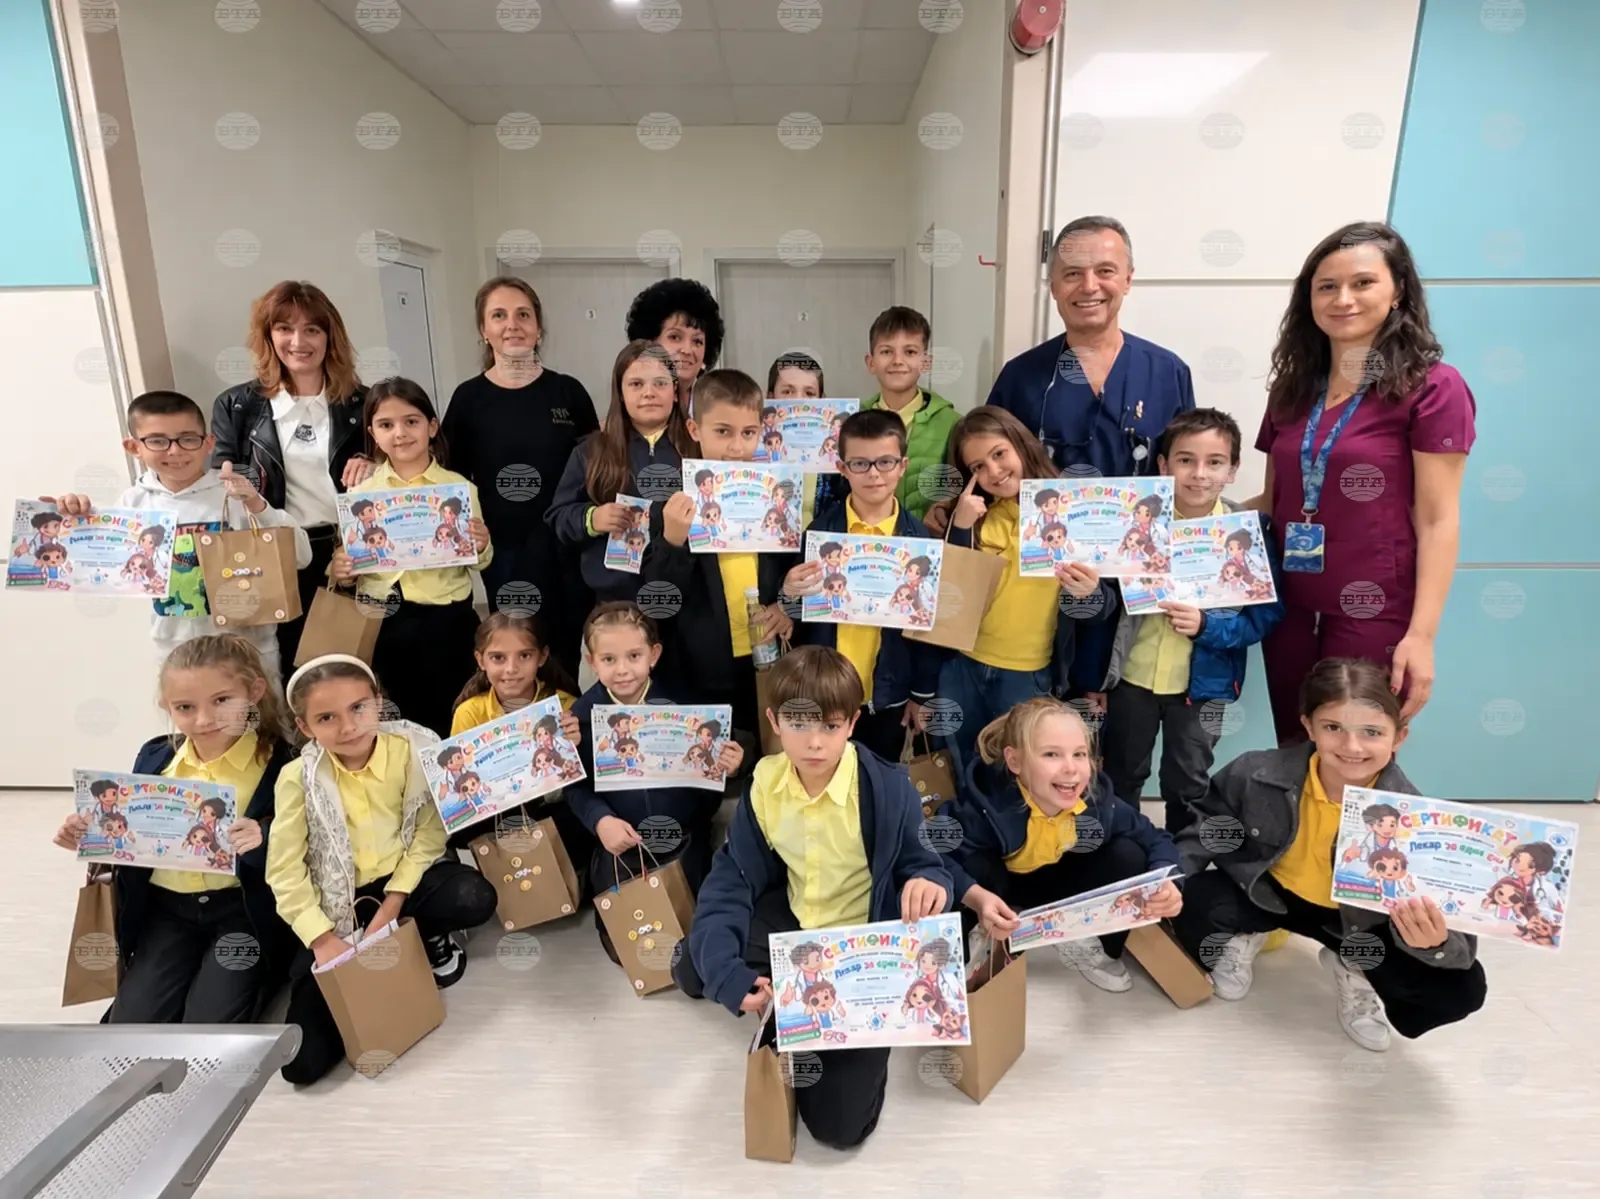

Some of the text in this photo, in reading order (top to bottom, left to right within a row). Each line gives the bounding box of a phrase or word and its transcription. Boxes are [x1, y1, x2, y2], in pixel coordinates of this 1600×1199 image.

[1401, 812, 1518, 846] СЕРТИФИКАТ
[1409, 841, 1442, 852] Лекар
[824, 934, 920, 959] СЕРТИФИКАТ
